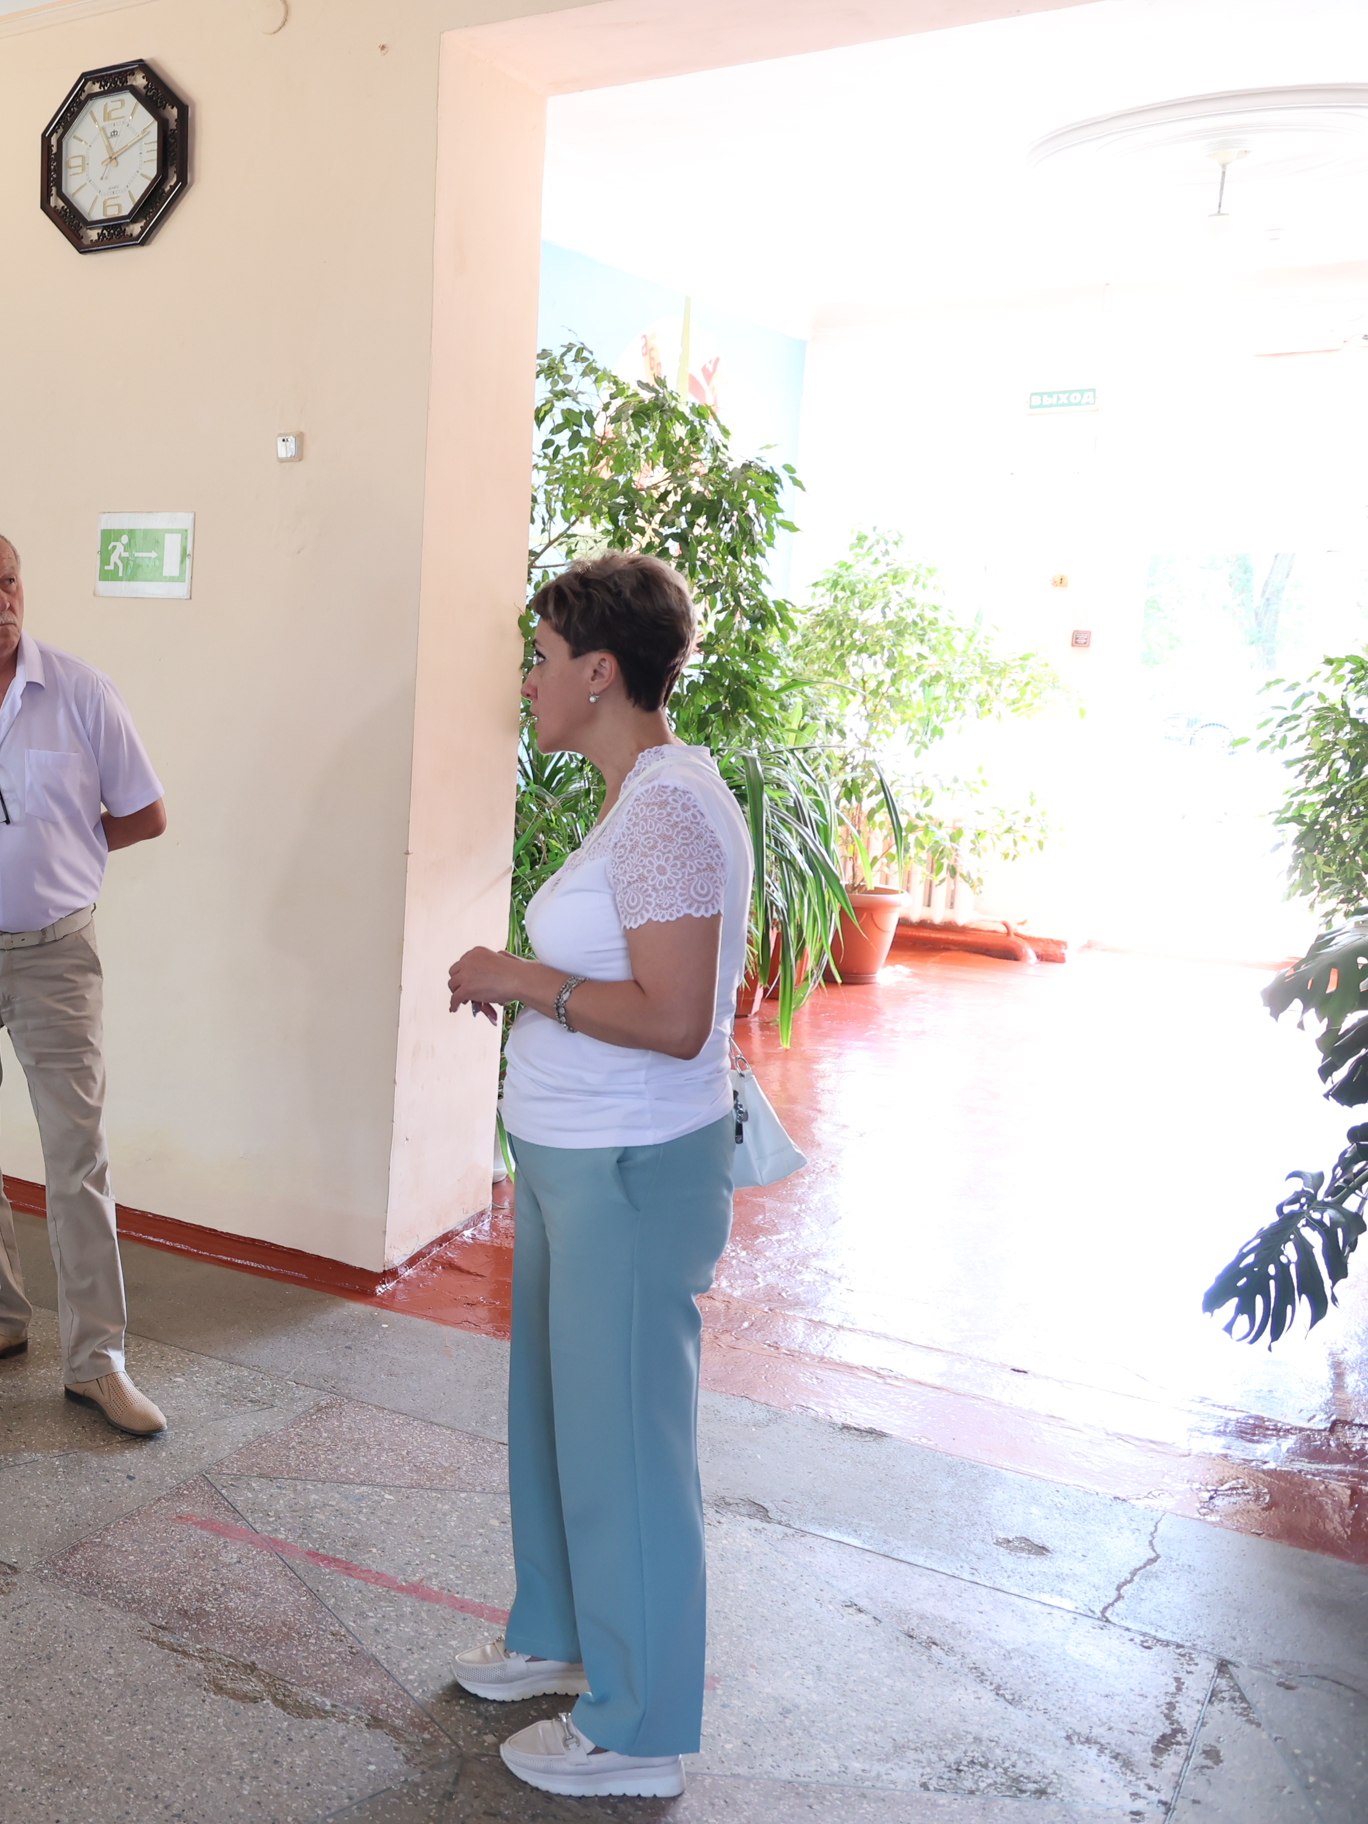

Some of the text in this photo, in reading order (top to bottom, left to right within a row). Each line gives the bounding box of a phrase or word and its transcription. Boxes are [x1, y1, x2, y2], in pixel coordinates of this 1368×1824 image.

[103, 98, 125, 122] 12
[67, 154, 86, 177] 9
[102, 195, 122, 218] 6
[1030, 391, 1095, 406] ВЫХОД
